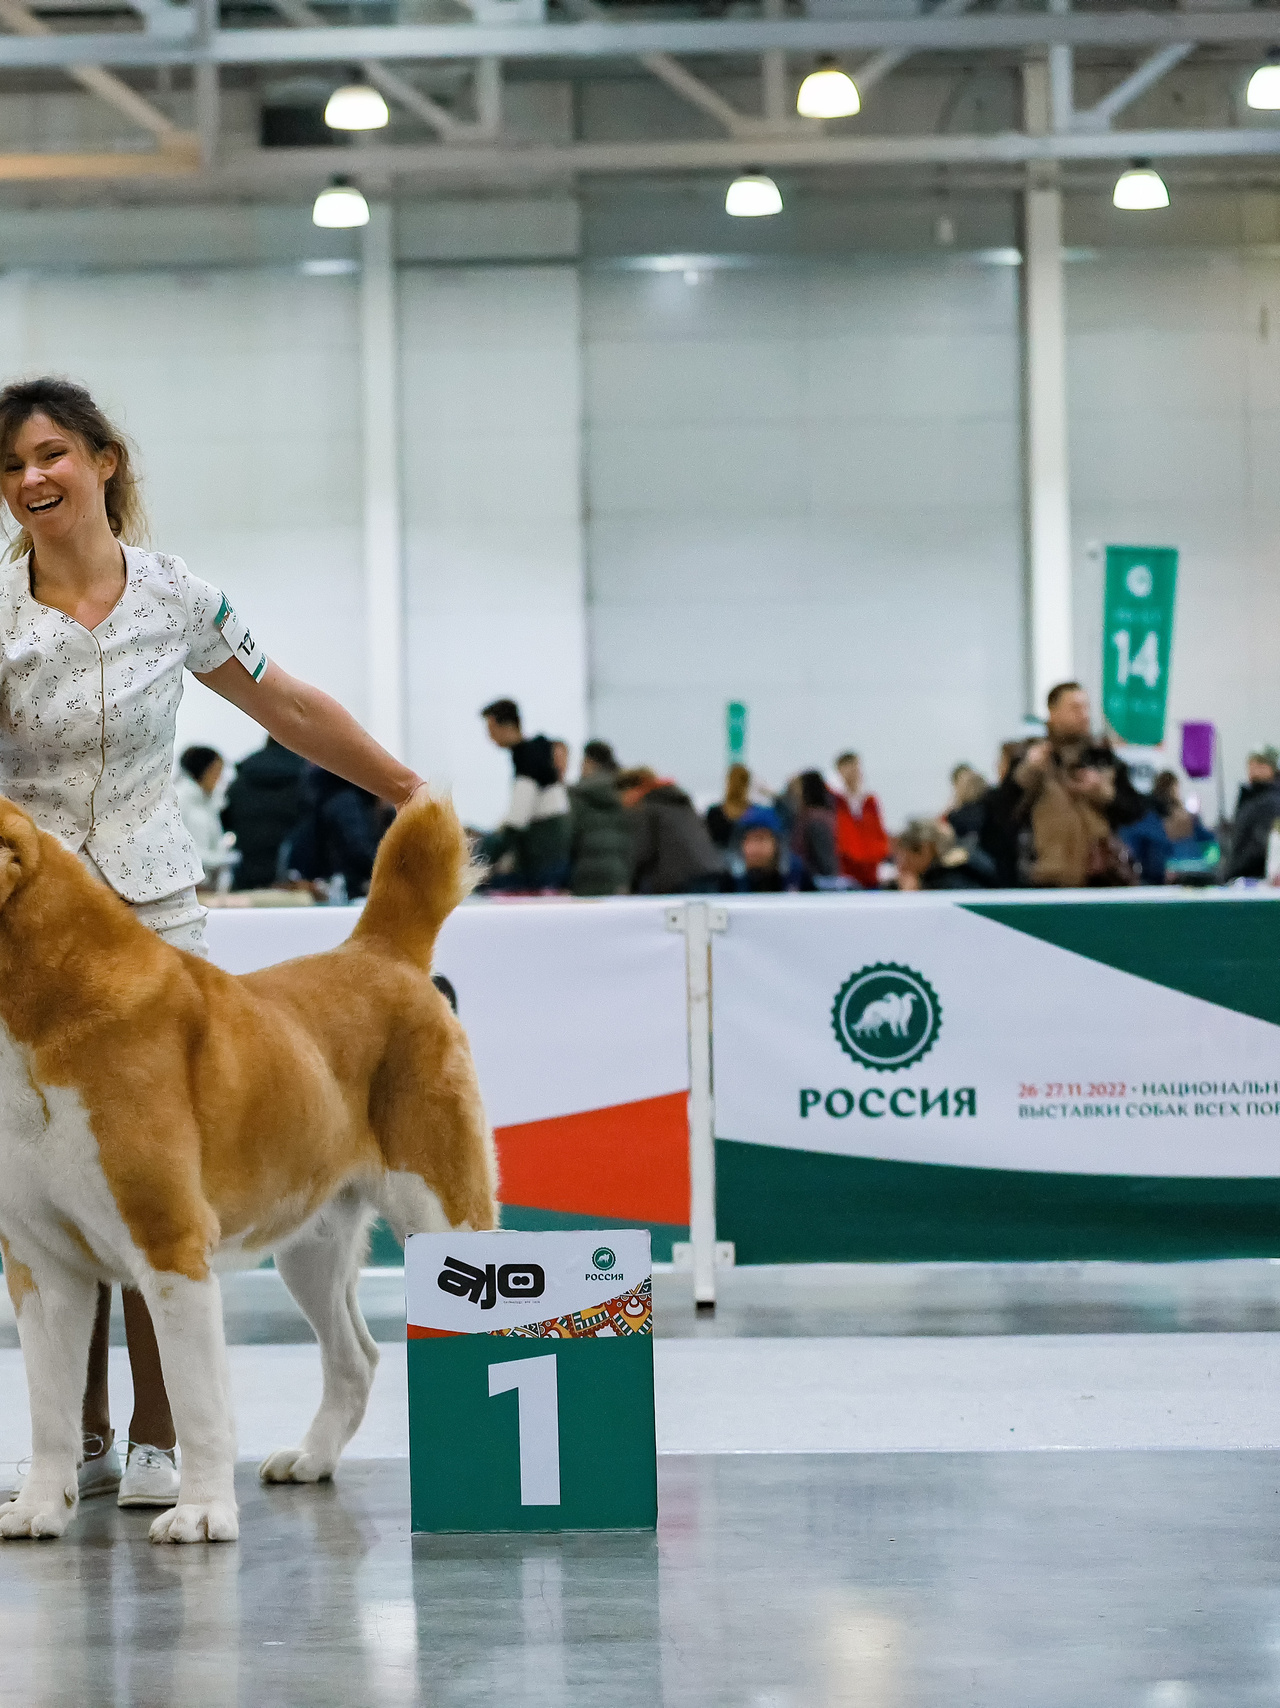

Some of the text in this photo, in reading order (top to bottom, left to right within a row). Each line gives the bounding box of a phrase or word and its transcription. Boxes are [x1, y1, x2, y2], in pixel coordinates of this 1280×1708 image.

[1112, 628, 1161, 688] 14
[799, 1086, 977, 1119] РОССИЯ
[1018, 1102, 1121, 1119] ВЫСТАВКИ
[1126, 1101, 1190, 1118] СОБАК
[1195, 1100, 1242, 1117] ВСЕХ
[585, 1273, 624, 1281] РОССИЯ
[488, 1353, 561, 1506] 1
